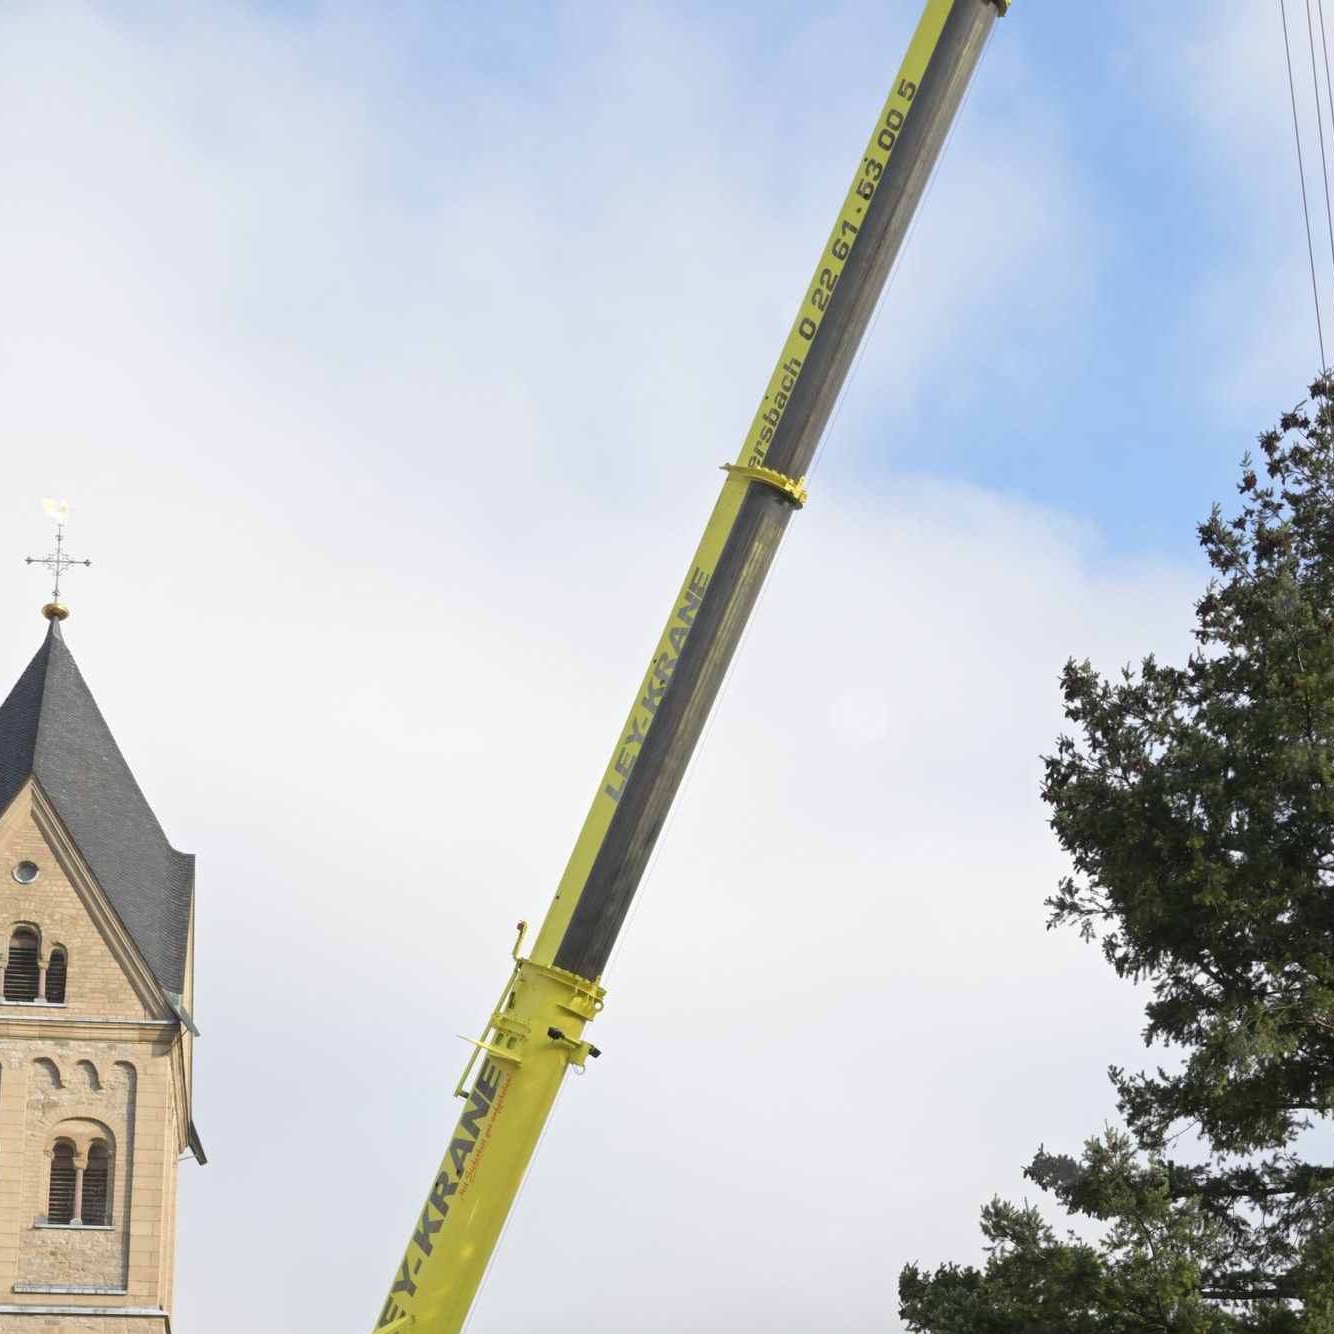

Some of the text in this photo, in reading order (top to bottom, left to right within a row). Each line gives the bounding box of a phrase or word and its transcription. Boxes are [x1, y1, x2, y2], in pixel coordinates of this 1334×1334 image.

[798, 316, 817, 342] 0
[811, 268, 839, 312] 22
[831, 219, 858, 262] 61
[856, 157, 884, 201] 53
[876, 108, 905, 152] 00
[897, 78, 917, 102] 5
[604, 566, 710, 803] LEY-KRANE
